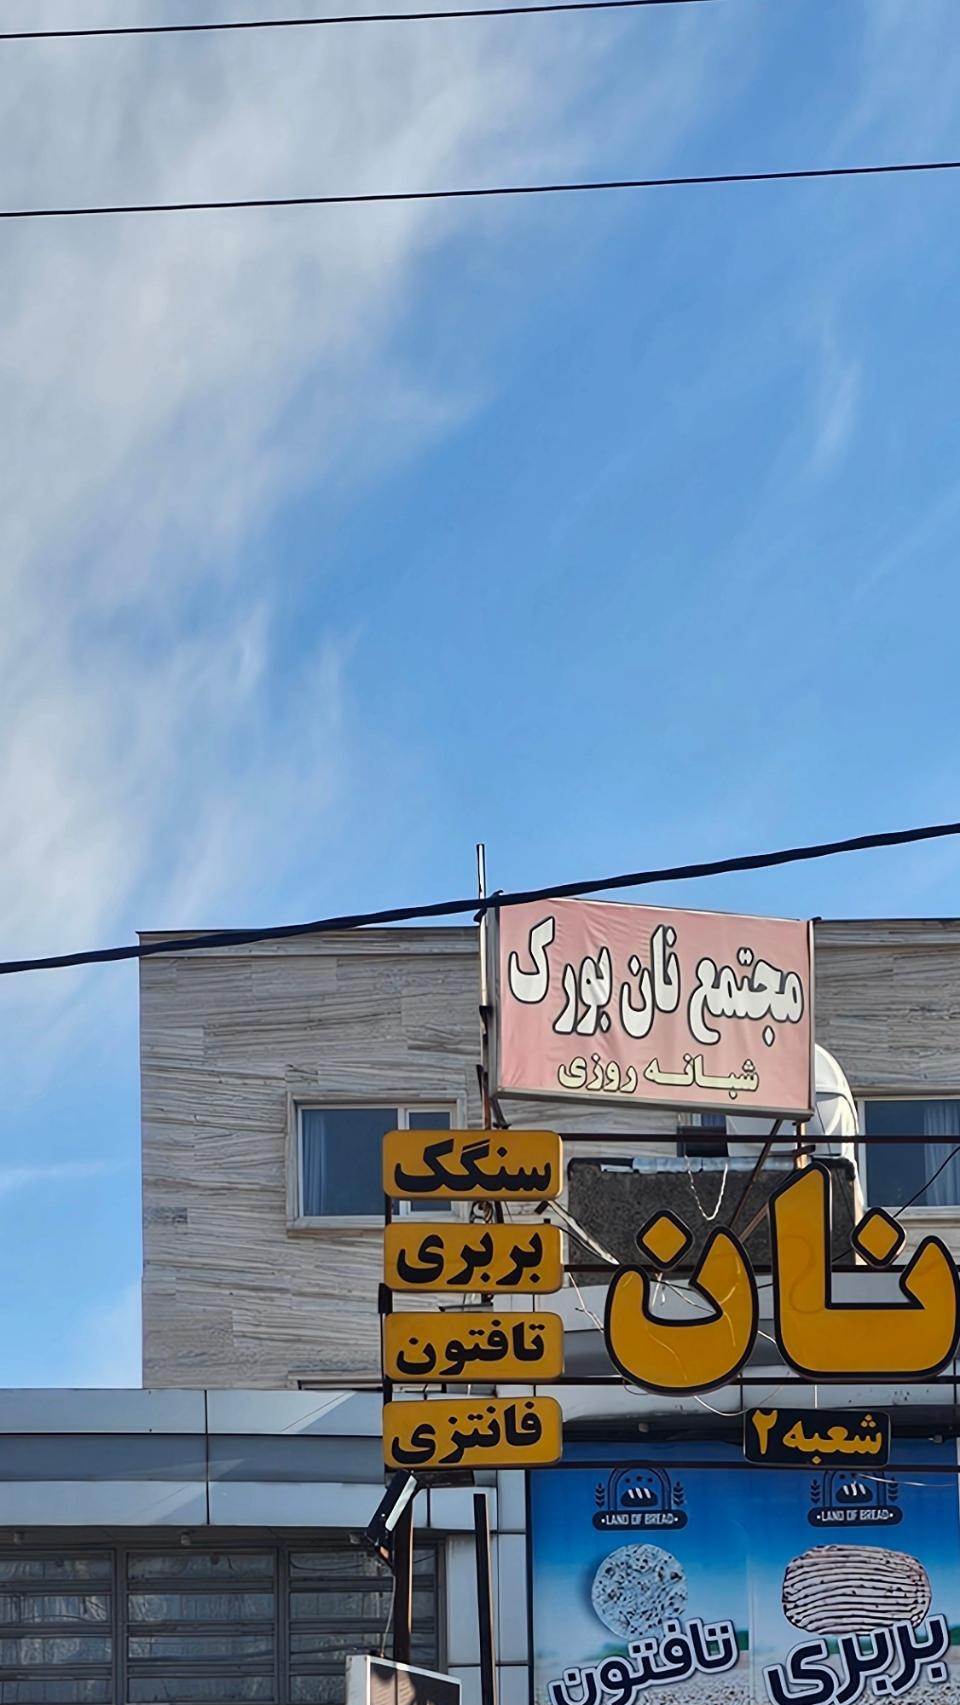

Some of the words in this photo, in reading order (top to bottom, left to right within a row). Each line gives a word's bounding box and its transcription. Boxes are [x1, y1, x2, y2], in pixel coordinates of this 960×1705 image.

[619, 924, 681, 1039] نان
[687, 947, 804, 1046] مجتمع
[558, 1053, 638, 1093] روزی
[643, 1053, 760, 1100] شبانه
[393, 1138, 554, 1193] سنگک
[396, 1229, 545, 1287] بربری
[395, 1321, 547, 1377] تافتون
[390, 1403, 543, 1465] فانتزی
[782, 1413, 883, 1465] شعبه
[605, 1514, 629, 1525] LAND
[631, 1513, 642, 1525] OF
[821, 1510, 844, 1521] LAND
[846, 1510, 858, 1521] OF
